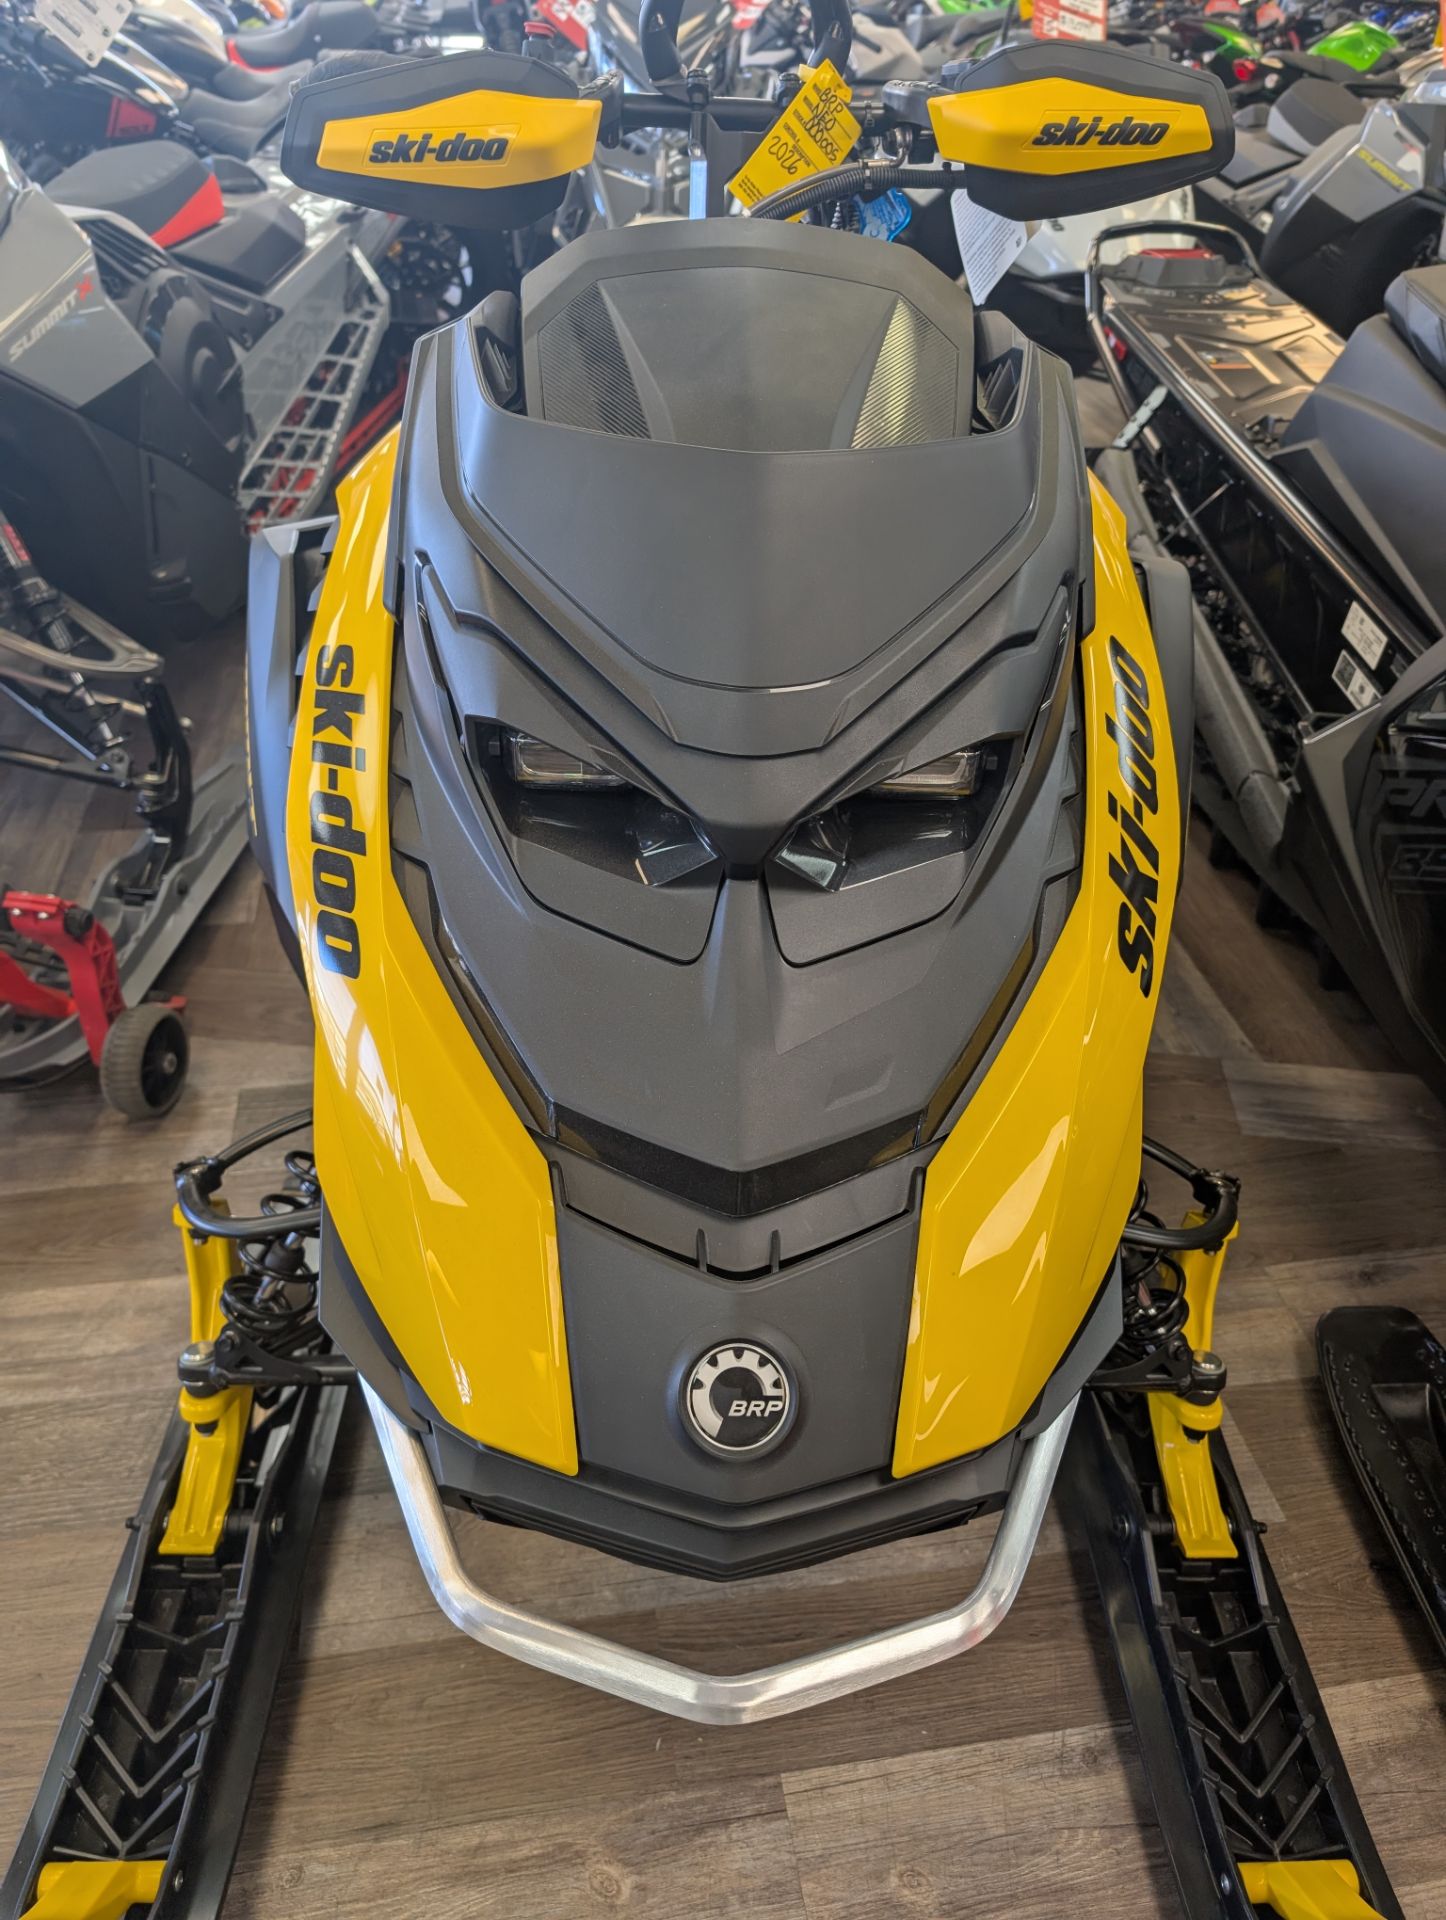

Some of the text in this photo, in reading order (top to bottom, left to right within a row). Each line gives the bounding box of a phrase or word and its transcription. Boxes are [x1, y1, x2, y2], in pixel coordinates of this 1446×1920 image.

[819, 87, 844, 114] BRP
[811, 103, 836, 131] NEO
[1032, 116, 1170, 146] ski-doo
[369, 132, 509, 163] ski-doo
[768, 135, 798, 175] 2026
[310, 644, 367, 980] ski-doo
[1105, 635, 1160, 999] ski-doo
[728, 1400, 783, 1418] BRP
